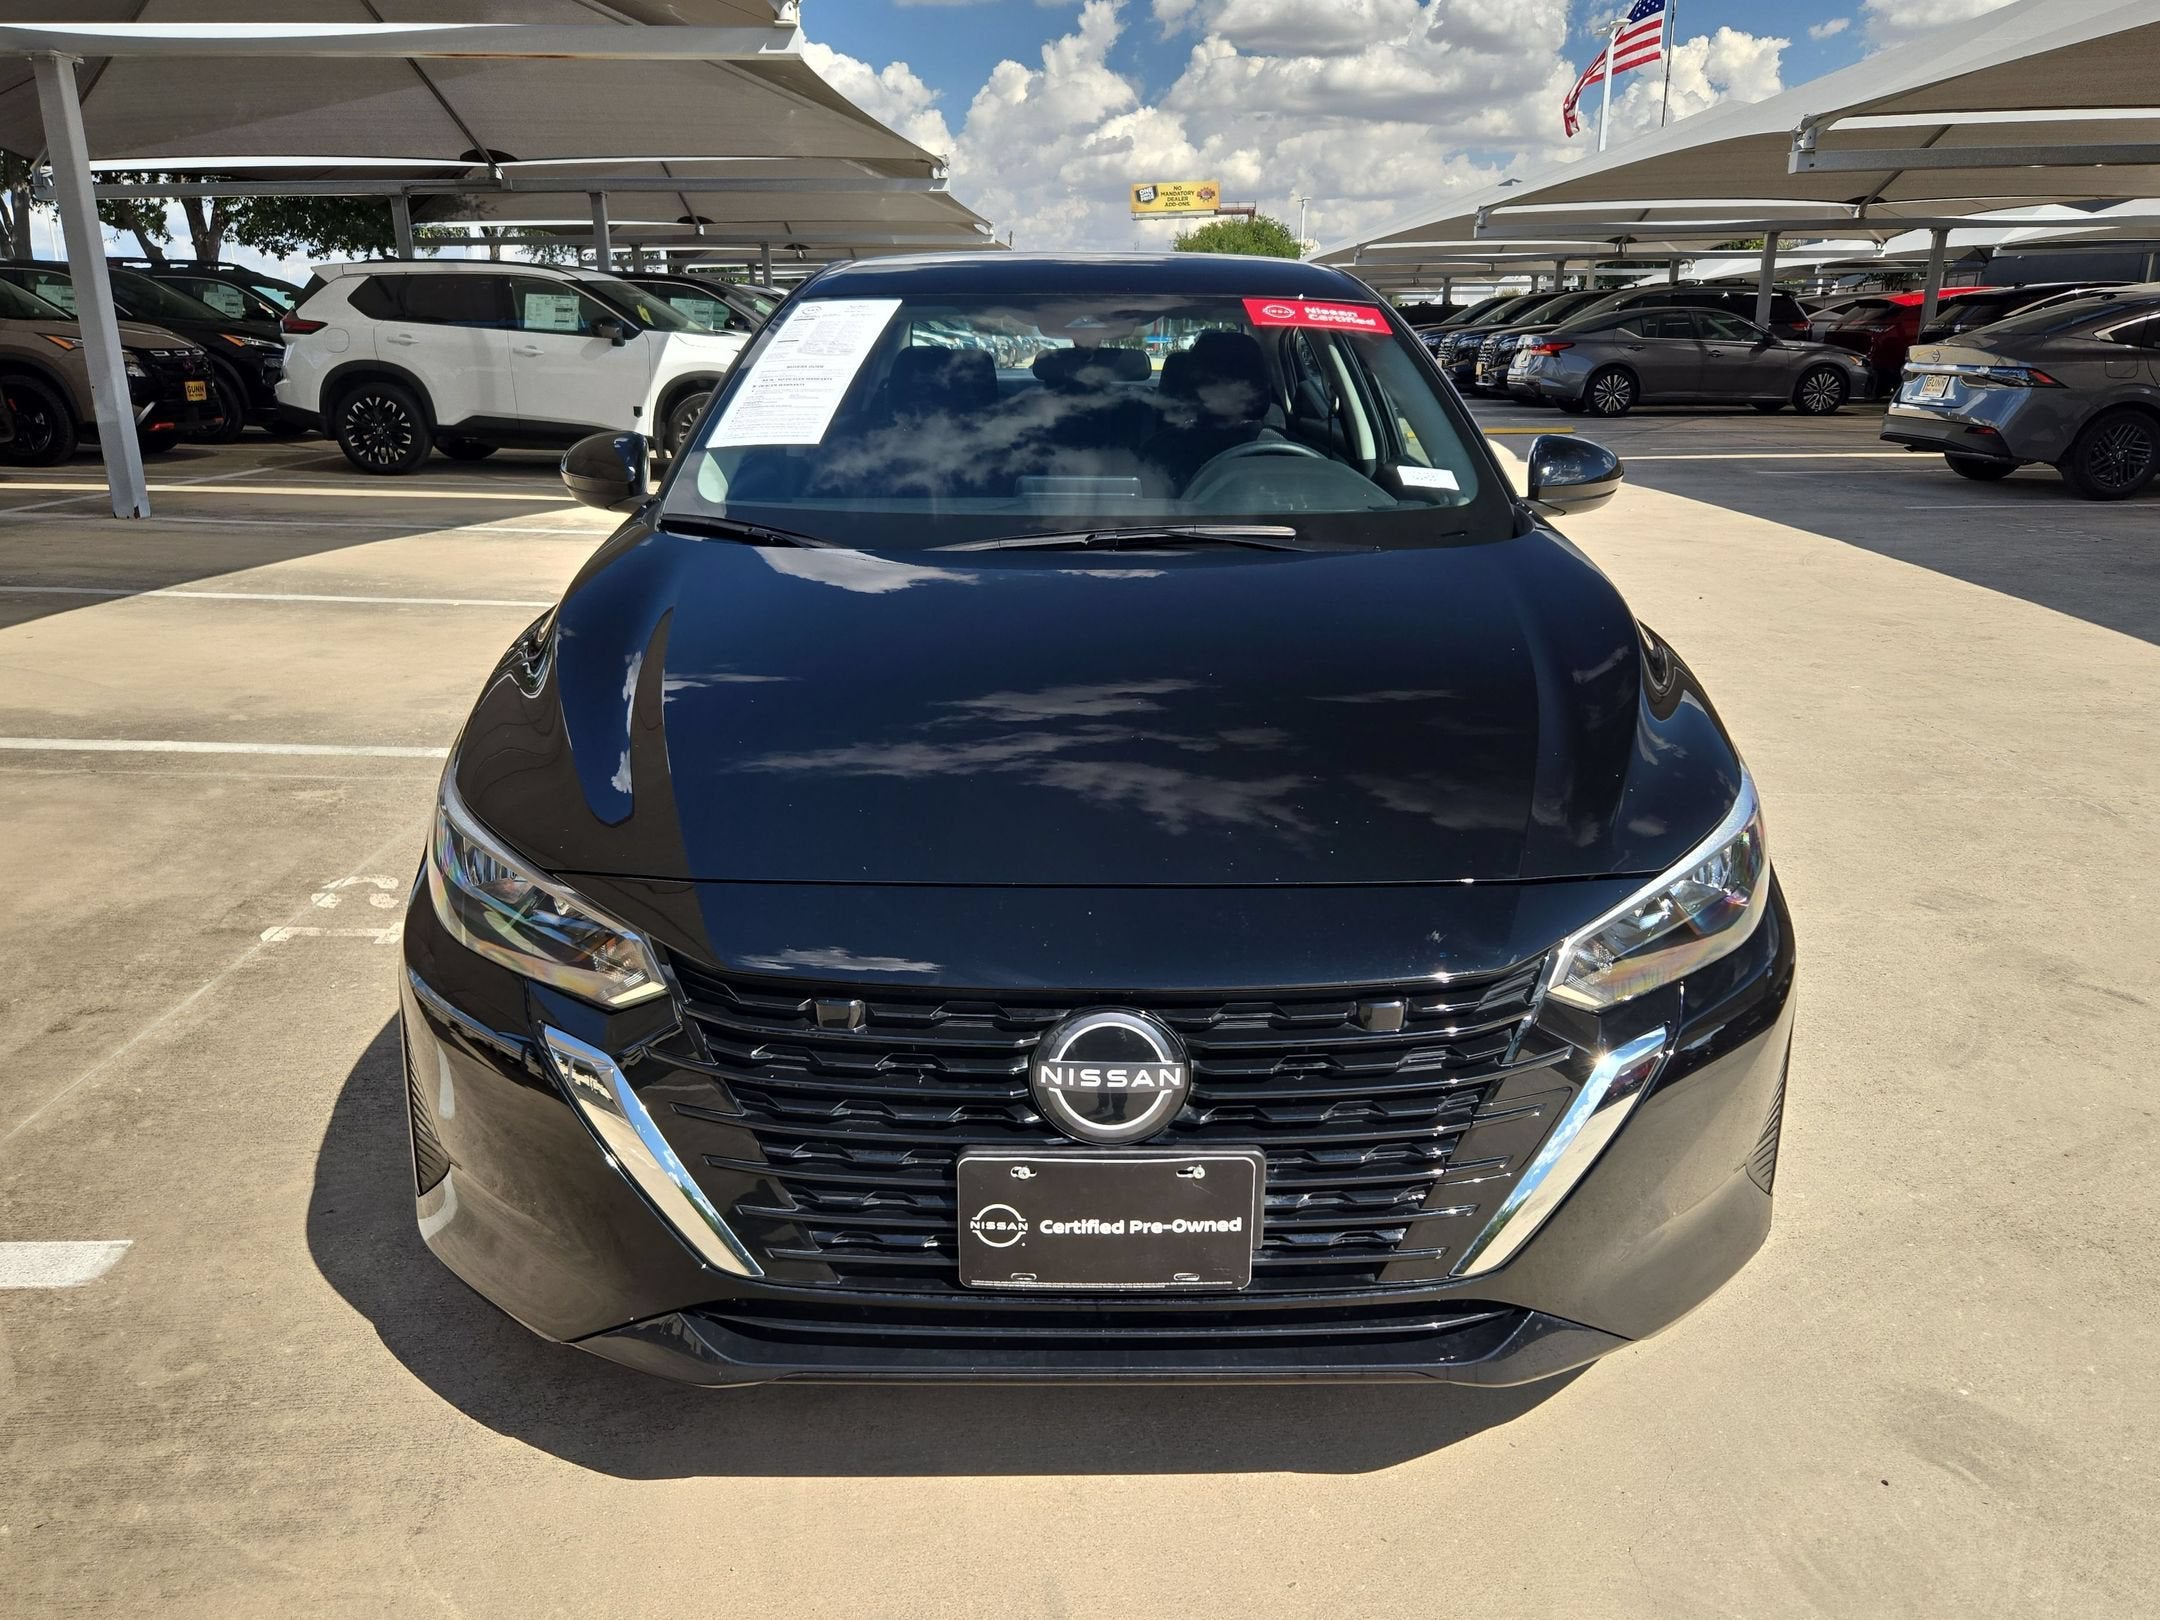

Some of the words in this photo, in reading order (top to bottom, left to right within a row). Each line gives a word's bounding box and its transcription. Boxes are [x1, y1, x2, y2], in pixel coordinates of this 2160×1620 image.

[1305, 307, 1358, 317] Nissan
[1308, 314, 1376, 326] Certified
[187, 385, 205, 393] GUNN
[1040, 1065, 1182, 1088] NISSAN
[970, 1220, 1029, 1231] NISSAN
[1039, 1218, 1125, 1235] Certified
[1129, 1217, 1243, 1234] Pre-Owned
